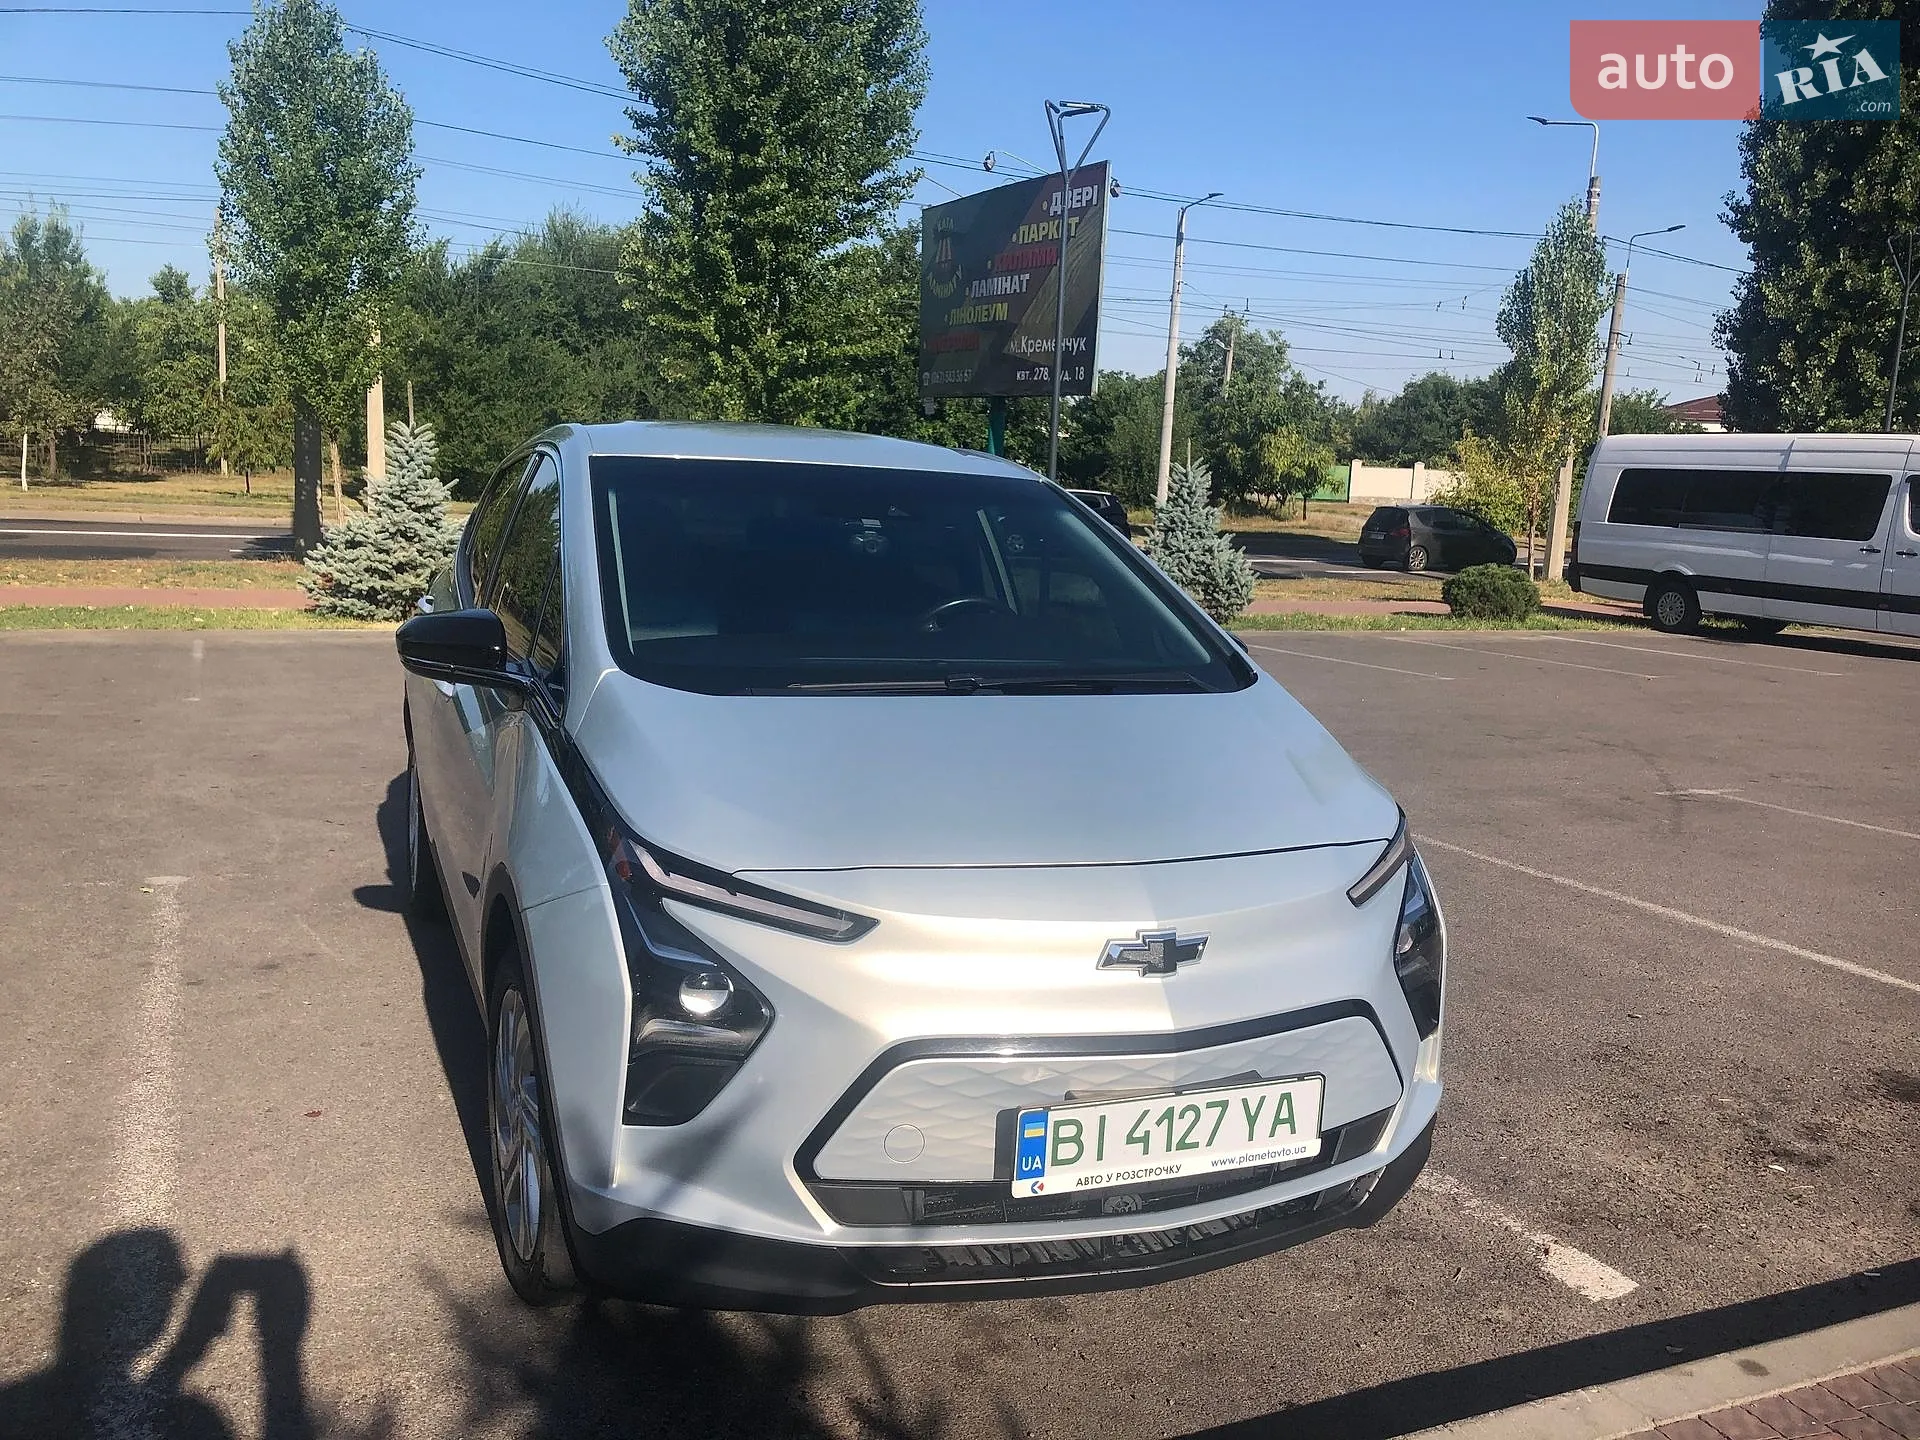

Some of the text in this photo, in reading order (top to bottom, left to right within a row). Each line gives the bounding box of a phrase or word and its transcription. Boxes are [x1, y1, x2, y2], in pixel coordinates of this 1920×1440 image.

[1049, 184, 1099, 216] ДВЕРІ
[1018, 217, 1080, 245] ПАРКТ
[971, 273, 1030, 298] ЛАМІНАТ
[949, 303, 1008, 326] ЛІНОЛЕУМ
[1075, 366, 1086, 380] 18
[1050, 1091, 1297, 1167] BI 4127 YA
[1021, 1154, 1043, 1172] UA
[1210, 1144, 1308, 1168] www.planetavto.ua
[1075, 1163, 1183, 1188] АВТО У РОЗСТРОЧКУ
